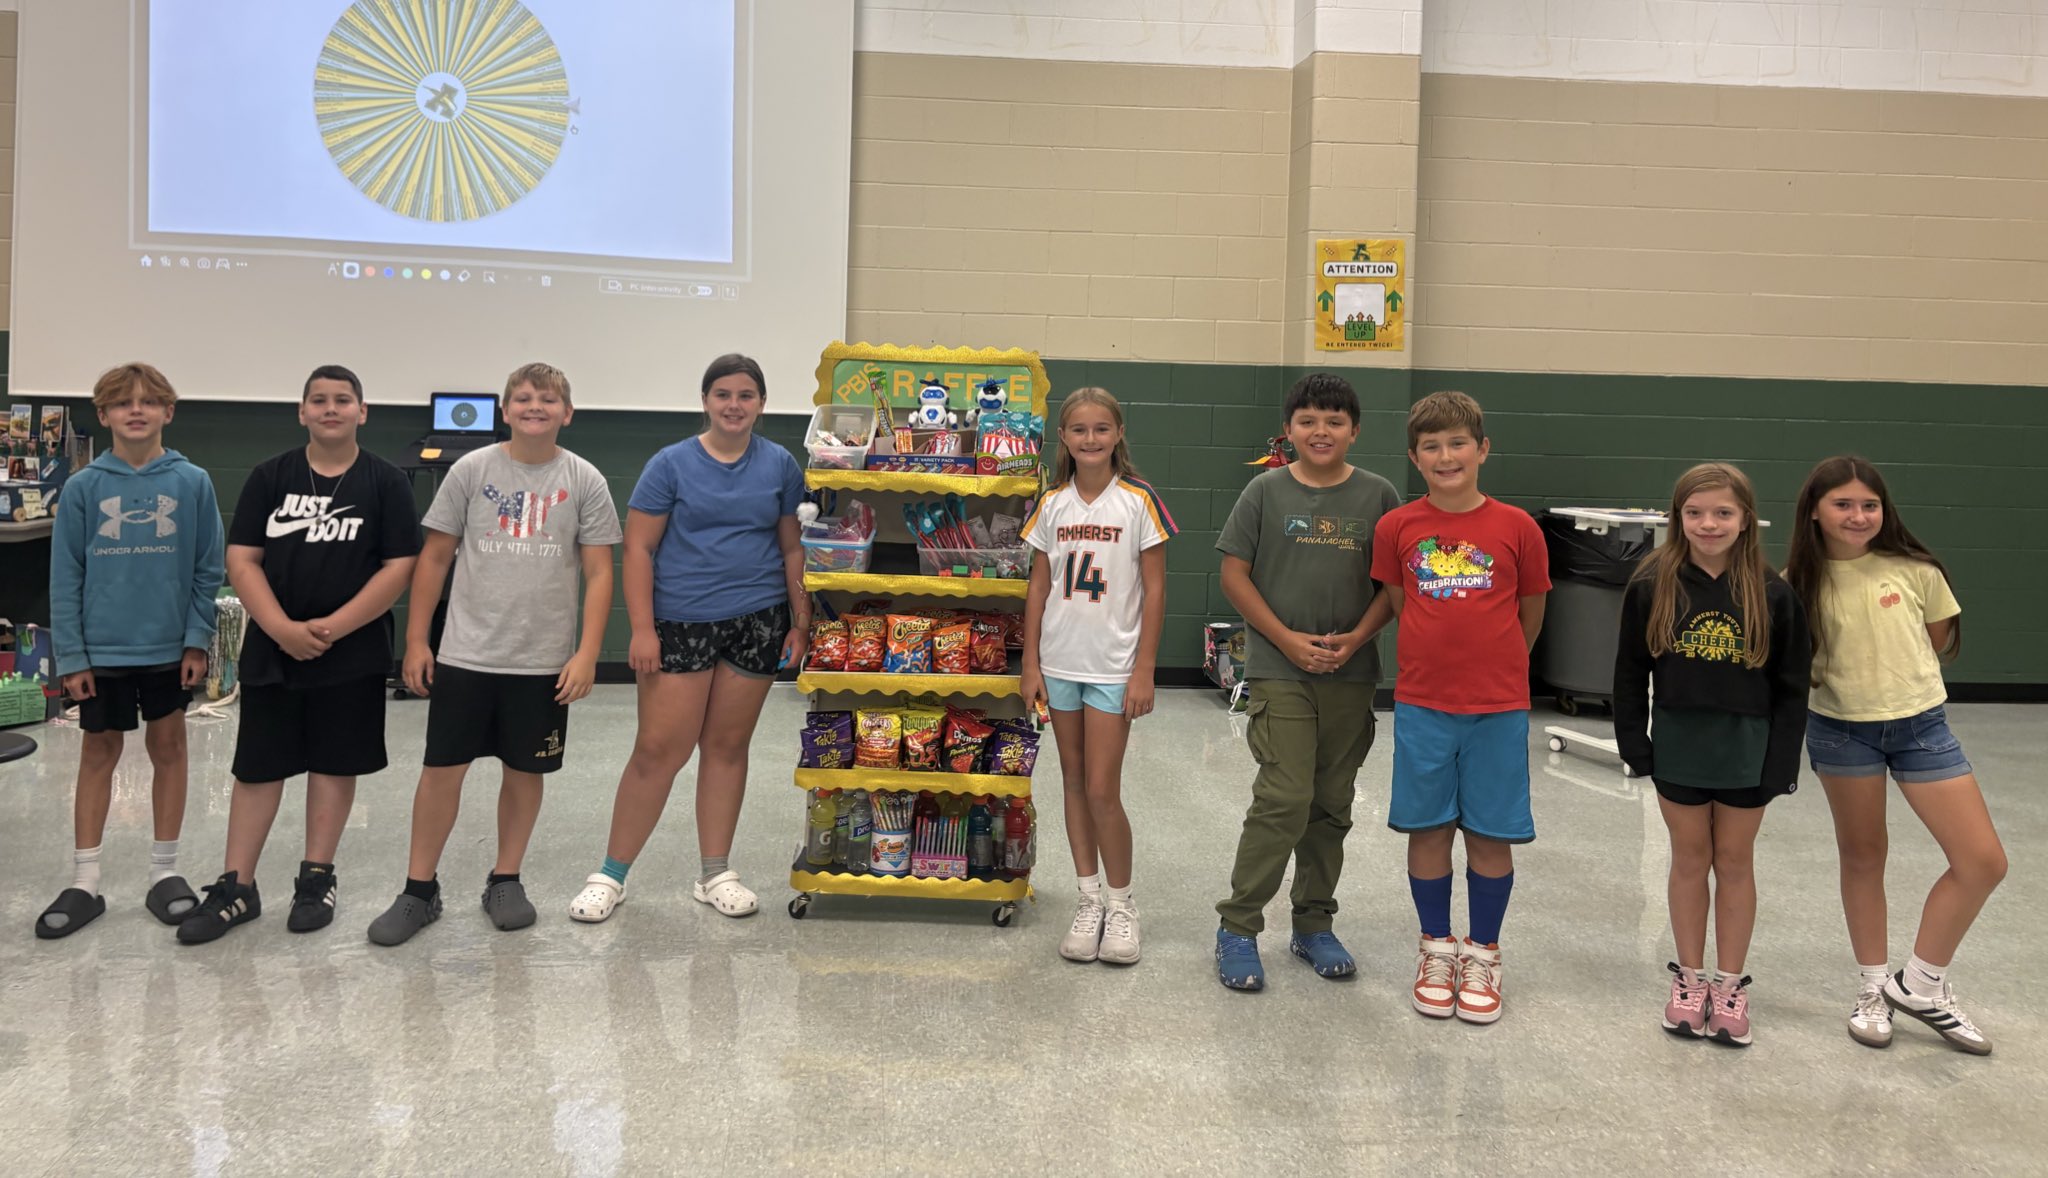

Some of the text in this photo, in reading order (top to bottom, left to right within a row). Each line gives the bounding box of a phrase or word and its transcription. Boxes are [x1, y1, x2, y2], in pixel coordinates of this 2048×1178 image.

[1327, 264, 1394, 274] ATTENTION
[1347, 323, 1373, 331] LEVEL
[1354, 331, 1367, 339] UP
[836, 362, 1031, 403] PBIS RFFE
[996, 458, 1033, 472] AIRHEADS
[277, 493, 334, 518] JUST
[1057, 524, 1123, 543] AMHERST
[1295, 536, 1355, 545] PANAJACHEL
[93, 545, 176, 556] UNDER ARMOU
[478, 539, 503, 553] JULY
[539, 543, 562, 557] 1776
[1063, 550, 1108, 603] 14
[1418, 576, 1484, 591] CELEBRATION!
[1689, 610, 1742, 634] AMHERST YOUTH
[893, 619, 931, 641] Cheetos
[1691, 634, 1736, 649] CHEER
[953, 730, 982, 743] Doritos
